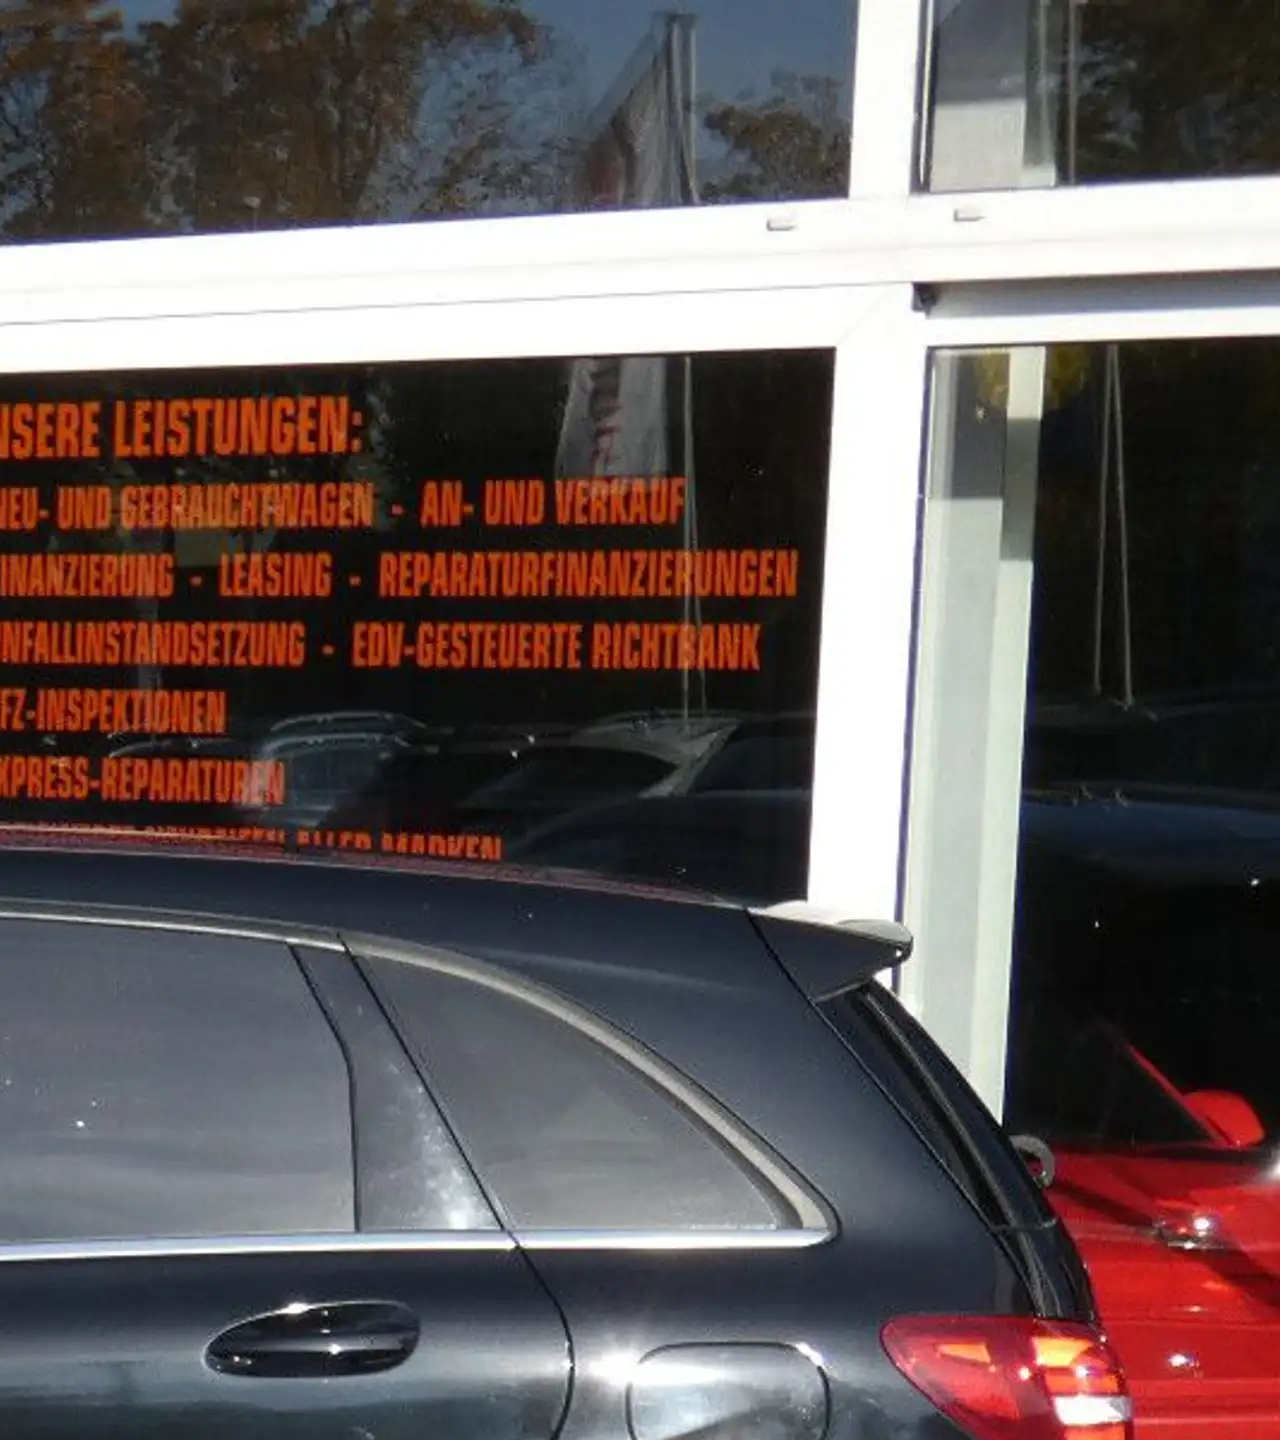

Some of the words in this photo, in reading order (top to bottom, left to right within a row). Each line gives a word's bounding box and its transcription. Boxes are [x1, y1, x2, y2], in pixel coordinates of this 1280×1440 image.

[114, 396, 362, 458] LEISTUNGEN:
[57, 486, 113, 530] UND
[119, 483, 374, 530] GEBRAUCHTWAGEN
[420, 481, 474, 526] AN-
[484, 480, 545, 526] UND
[555, 476, 686, 525] VERKAUF
[220, 552, 333, 597] LEASING
[379, 549, 798, 598] REPARATURFINANZIERUNGEN
[352, 622, 582, 669] EDV-GESTEUERTE
[591, 621, 761, 670] RICHTBANK
